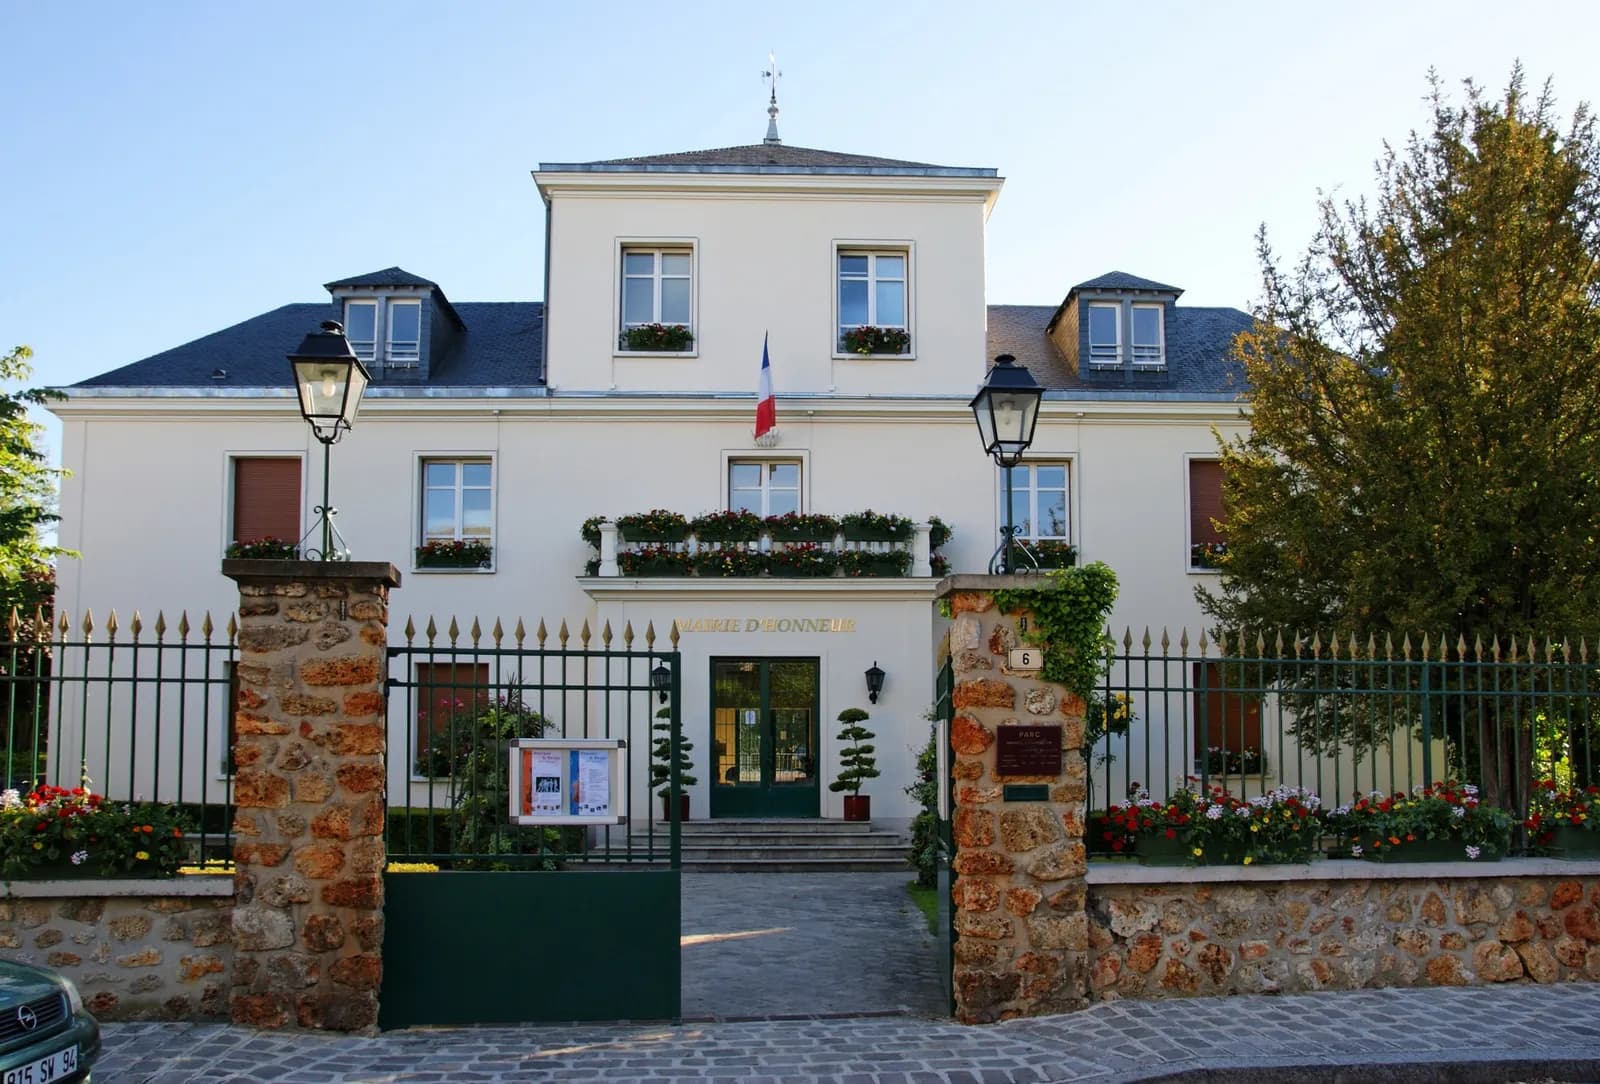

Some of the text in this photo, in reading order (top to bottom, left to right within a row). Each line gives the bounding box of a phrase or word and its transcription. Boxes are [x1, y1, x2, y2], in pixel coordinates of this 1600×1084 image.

[676, 617, 856, 632] MAIRIE D'HONNEUR
[1022, 653, 1030, 665] 6
[40, 1057, 55, 1083] SW
[63, 1049, 75, 1072] 94
